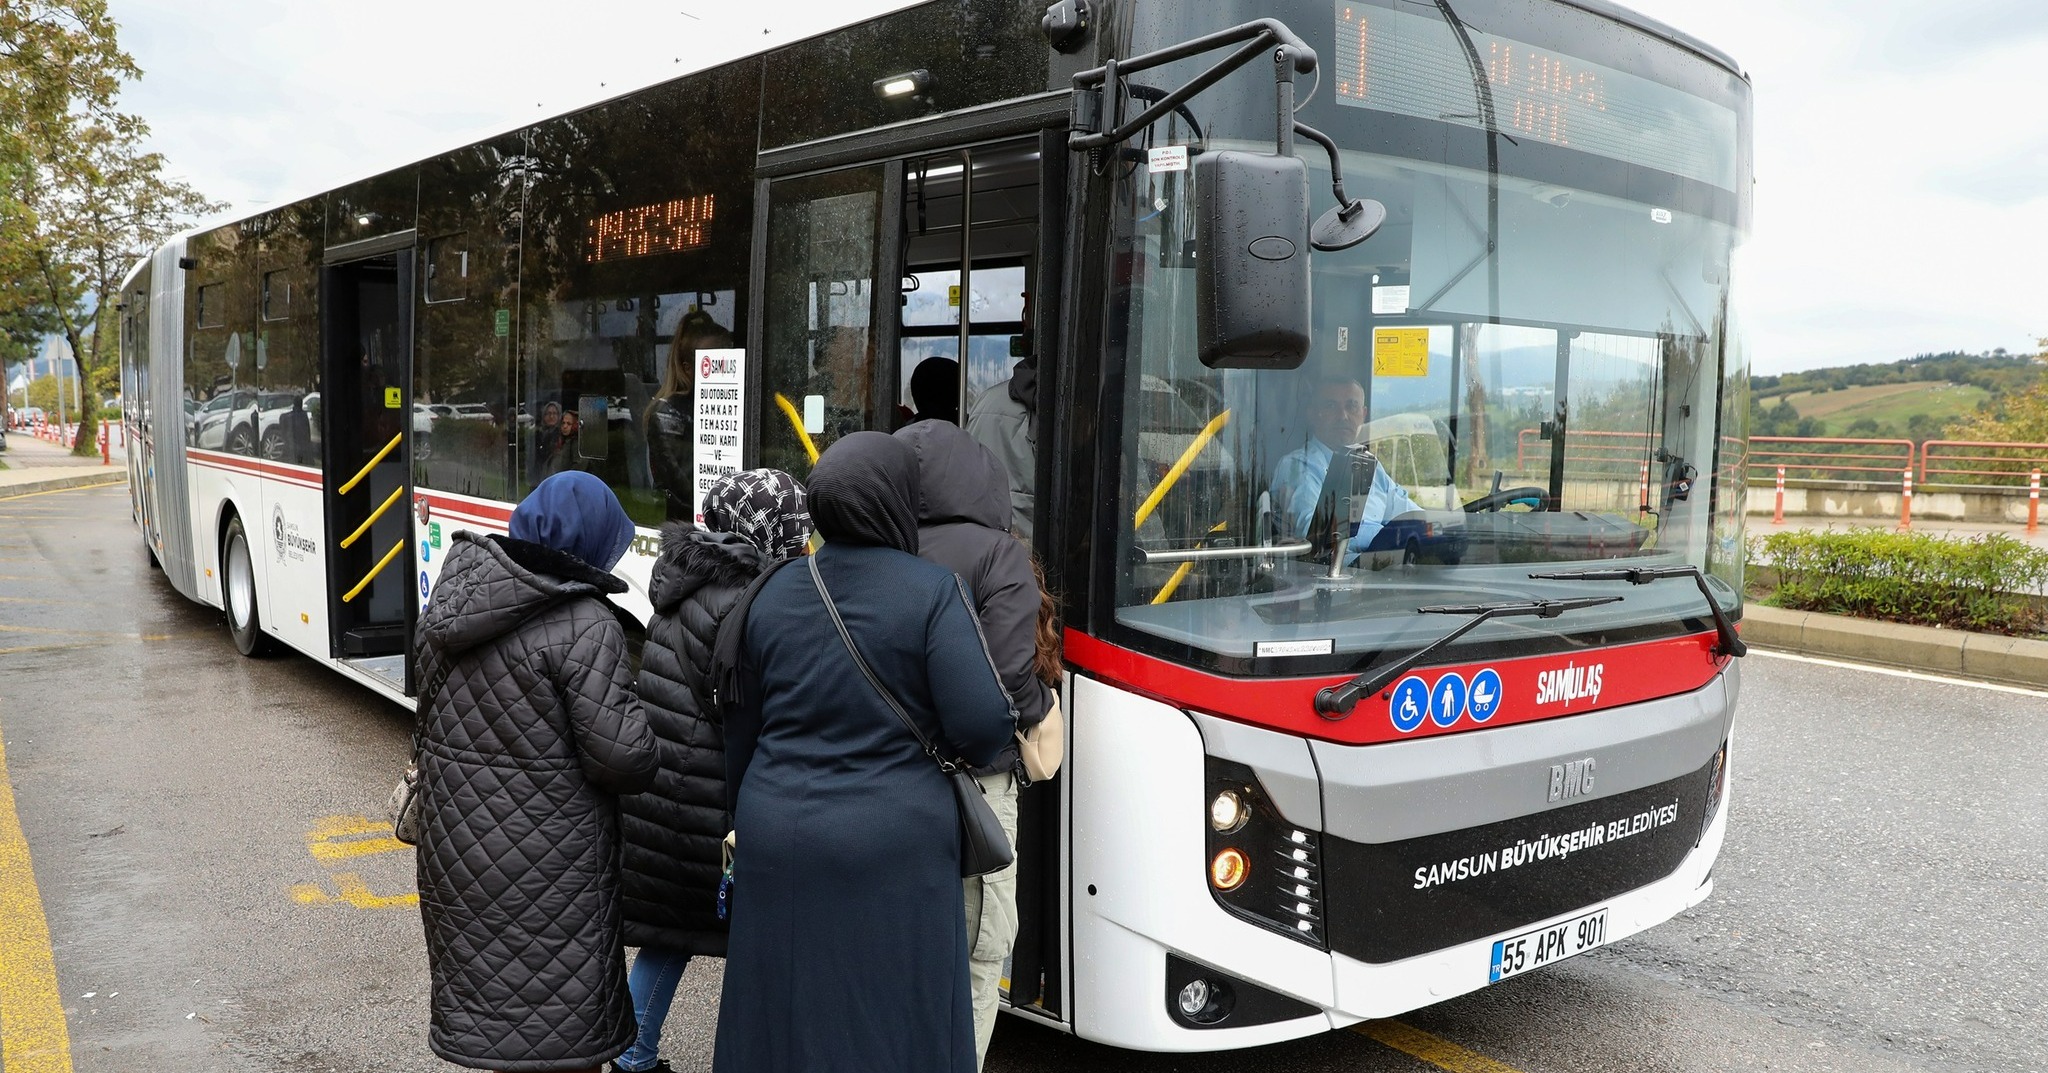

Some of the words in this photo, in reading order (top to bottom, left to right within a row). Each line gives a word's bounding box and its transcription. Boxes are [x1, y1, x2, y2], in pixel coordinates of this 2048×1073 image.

[699, 404, 738, 416] SAMKART
[699, 418, 738, 432] TEMASSIZ
[719, 435, 738, 447] KARTI
[714, 449, 722, 461] VE
[699, 463, 718, 476] BANKA
[1547, 757, 1596, 803] BMC
[1413, 850, 1497, 890] SAMSUN
[1500, 821, 1605, 870] BÜYÜKŞEHİR
[1607, 798, 1679, 842] BELEDİYESİ
[1492, 964, 1501, 974] TR
[1502, 939, 1526, 974] 55
[1534, 926, 1568, 964] APK
[1577, 914, 1604, 950] 901
